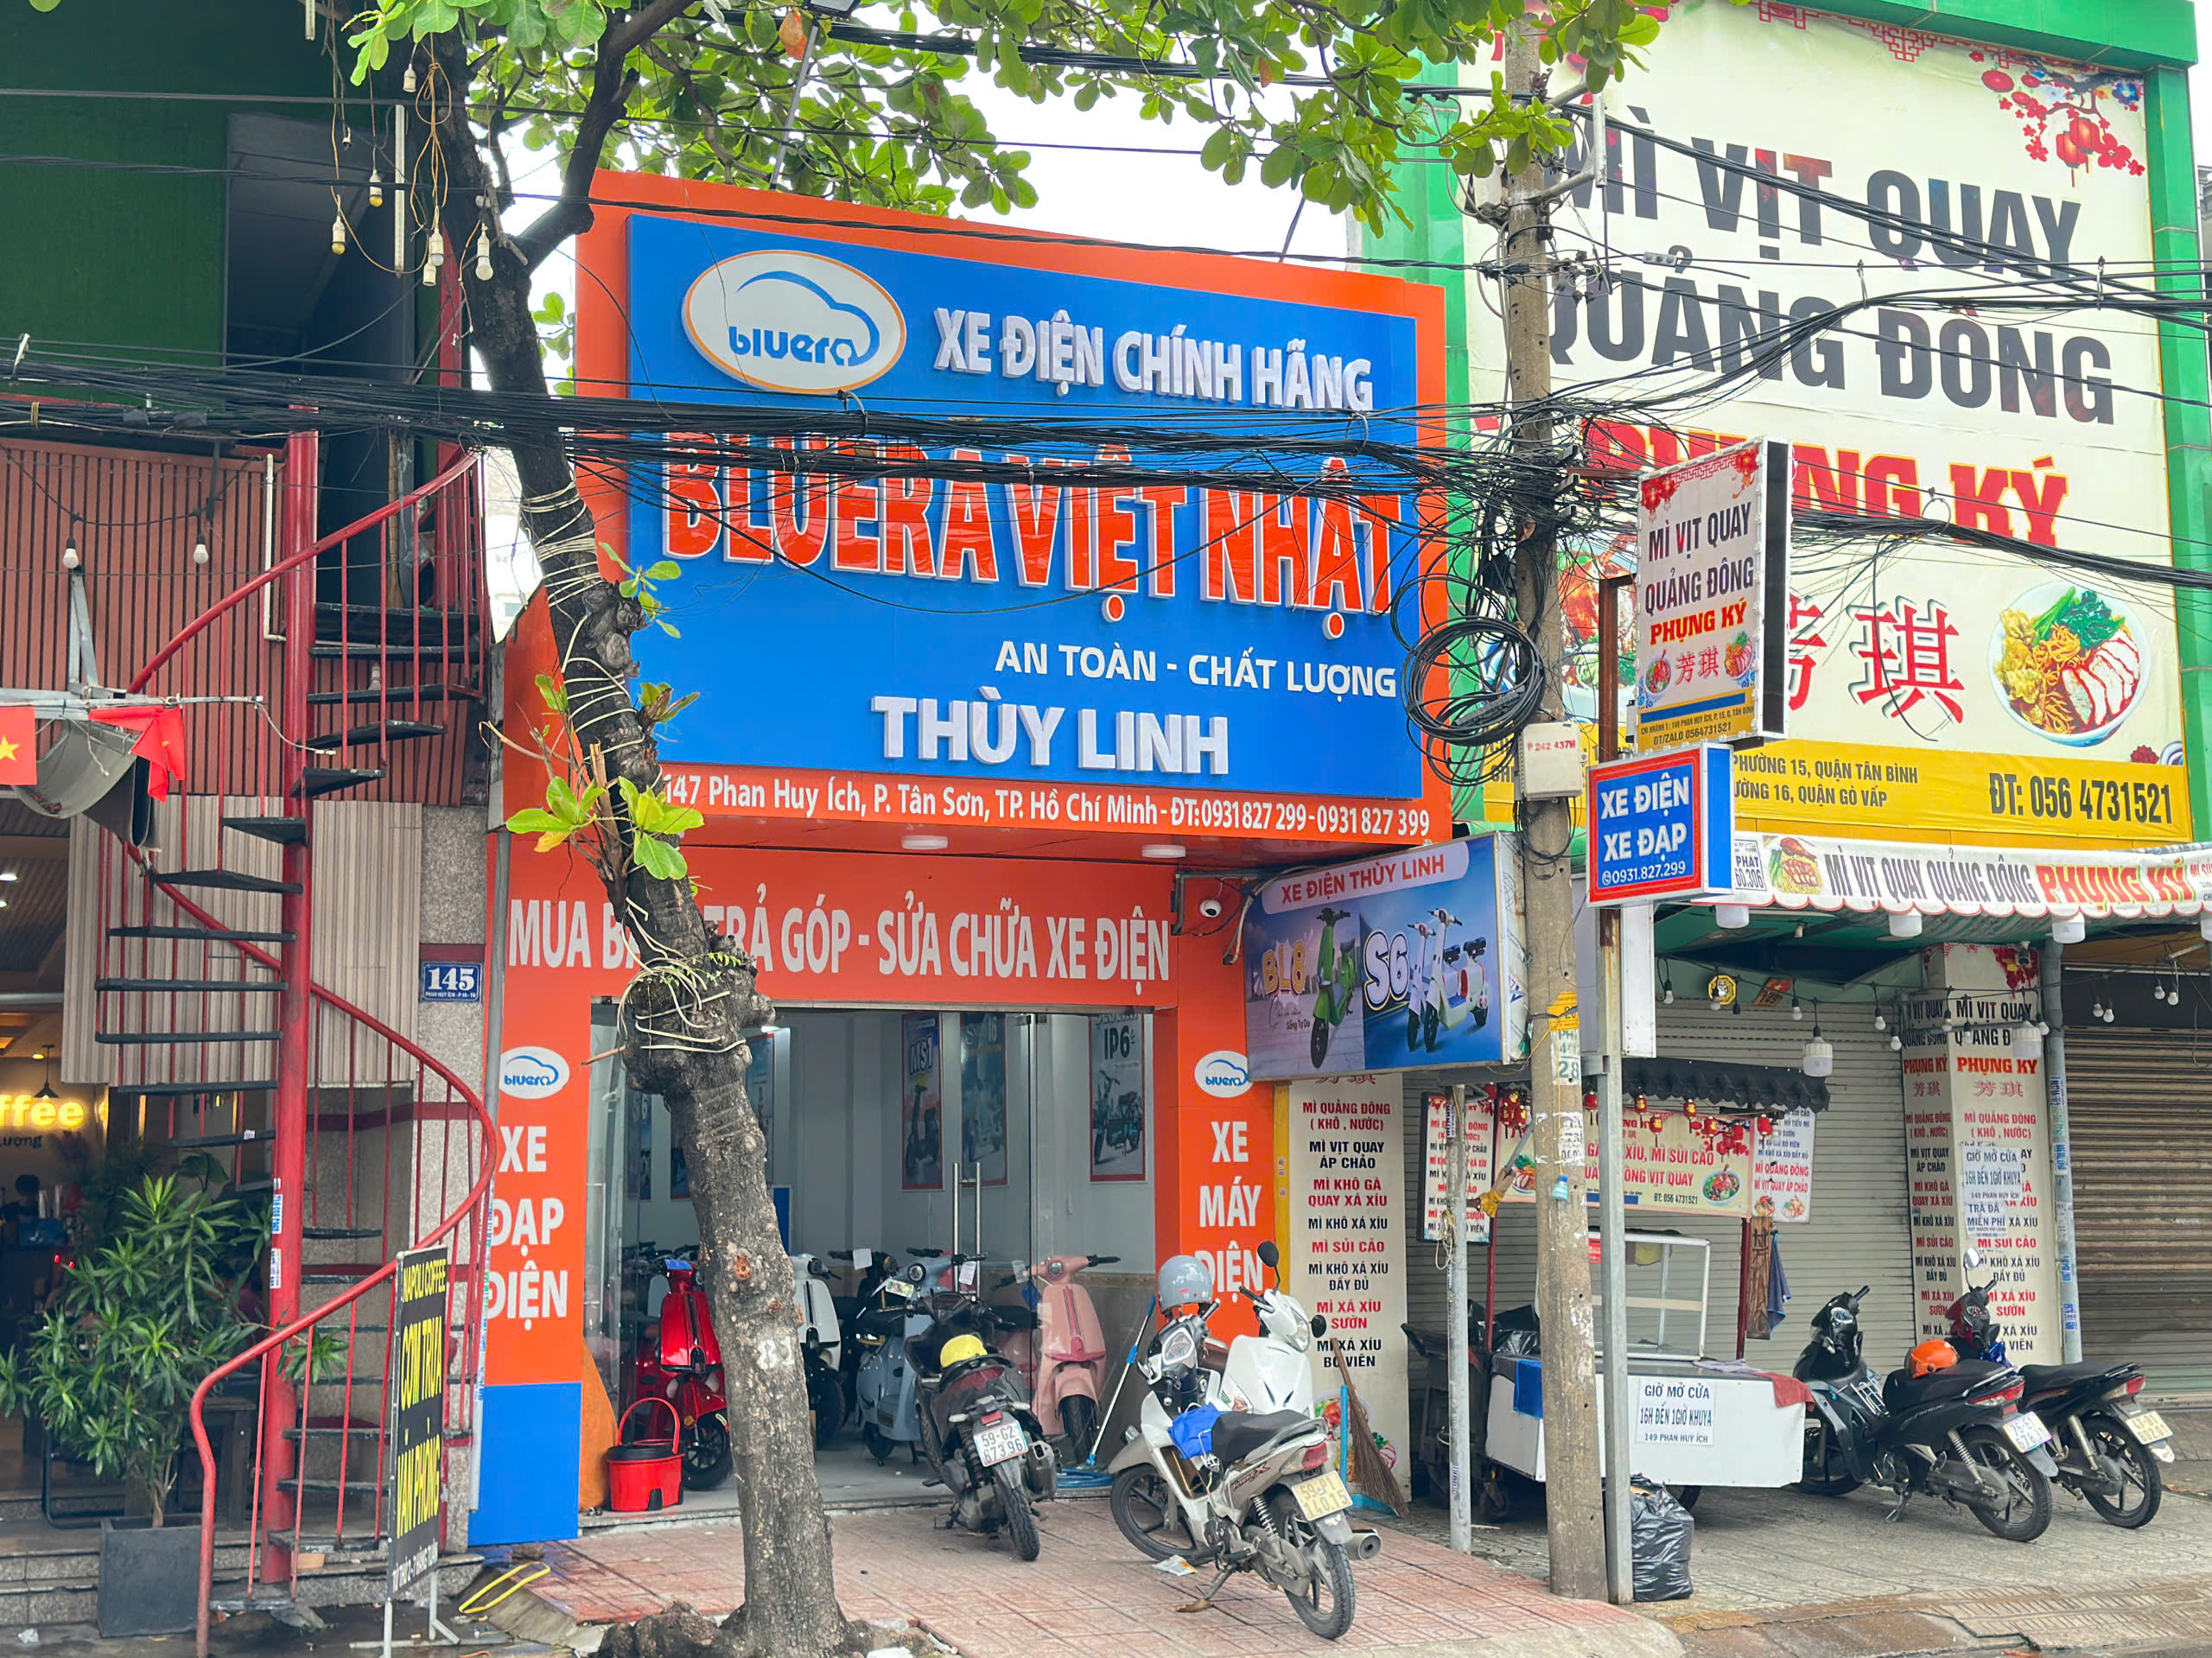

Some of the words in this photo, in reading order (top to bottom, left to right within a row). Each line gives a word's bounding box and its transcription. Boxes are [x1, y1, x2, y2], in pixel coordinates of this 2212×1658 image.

[1691, 137, 1832, 259] VỊT
[1866, 169, 2081, 280] QUAY
[933, 308, 992, 374] XE
[1000, 309, 1104, 397] ĐIỆN
[1113, 324, 1243, 402] CHÍNH
[1252, 338, 1374, 412] HÃNG
[1875, 302, 2114, 425] ĐÔNG
[1949, 455, 2069, 548] KÝ
[663, 430, 1000, 582] BLUERA
[1004, 443, 1187, 623] VIỆT
[1199, 456, 1402, 639] NHẬT
[1649, 519, 1670, 562] MÌ
[1675, 516, 1702, 560] VỊT
[1707, 501, 1751, 548] QUAY
[1644, 568, 1701, 617] QUẢNG
[1707, 557, 1755, 599] ĐÔNG
[1649, 609, 1715, 645] PHỤNG
[1720, 597, 1747, 629] KÝ
[995, 640, 1047, 675] AN
[1058, 642, 1156, 682] TOÀN
[1188, 646, 1277, 691] CHẤT
[1287, 660, 1397, 703] LƯỢNG
[871, 686, 1065, 766] THÙY
[1078, 708, 1229, 775] LINH
[1790, 759, 1812, 778] 15,
[1815, 759, 1853, 782] QUẬN
[1856, 761, 1882, 782] TÂN
[1886, 763, 1918, 784] BÌNH
[709, 774, 766, 808] Phan
[773, 778, 819, 818] Huy
[828, 776, 867, 817] Ích,
[874, 787, 892, 814] P.
[898, 785, 937, 816] Tân
[943, 787, 990, 823] Sơn,
[995, 790, 1025, 819] TP.
[1030, 787, 1059, 821] Hồ
[1066, 790, 1101, 824] Chí
[1600, 788, 1629, 820] XE
[1634, 772, 1690, 816] ĐIỆN
[1773, 784, 1794, 804] 16,
[1798, 784, 1835, 807] QUẬN
[1840, 785, 1858, 805] GÒ
[1861, 785, 1887, 807] VẤP
[1989, 772, 2024, 816] ĐT:
[2031, 775, 2073, 818] 056
[2079, 778, 2172, 824] 4731521
[1604, 831, 1631, 861] XE
[1637, 823, 1688, 861] ĐẠP
[1281, 885, 1301, 905] XE
[1306, 873, 1345, 901] ĐIỆN
[1349, 863, 1397, 890] THÙY
[1402, 854, 1445, 880] LINH
[1612, 861, 1686, 884] 0931.827.299
[1824, 845, 1853, 896] MÌ
[1850, 854, 1881, 908] VỊT
[1881, 858, 1928, 903] QUAY
[1926, 847, 1986, 905] QUẢNG
[1986, 854, 2040, 905] ĐÔNG
[2036, 865, 2153, 912] PHỤNG
[2146, 856, 2196, 902] KÝ
[509, 899, 591, 968] MUA
[782, 893, 851, 974] GÓP
[878, 890, 942, 976] SỬA
[950, 897, 1037, 978] CHỮA
[1046, 917, 1086, 980] XE
[1095, 905, 1169, 995] ĐIỆN
[429, 968, 474, 991] 145
[1262, 940, 1306, 994] BL8
[1977, 1001, 1997, 1023] VỊT
[1956, 1057, 2012, 1076] PHỤNG
[1303, 1100, 1317, 1114] MÌ
[1320, 1099, 1357, 1115] QUẢNG
[1361, 1102, 1390, 1115] ĐÔNG
[1979, 1109, 2010, 1124] QUẢNG
[1318, 1116, 1340, 1130] KHÔ
[499, 1126, 547, 1172] XE
[1211, 1121, 1249, 1162] XE
[1310, 1140, 1325, 1153] MÌ
[1319, 1155, 1337, 1169] ÁP
[1341, 1154, 1376, 1169] CHẢO
[1691, 1147, 1714, 1166] CẢO
[1313, 1177, 1330, 1191] MÌ
[1334, 1177, 1360, 1191] KHÔ
[1364, 1177, 1382, 1191] GÀ
[1649, 1171, 1666, 1188] VỊT
[1668, 1172, 1694, 1187] QUAY
[1199, 1176, 1262, 1228] MÁY
[1366, 1192, 1388, 1206] XÍU
[1308, 1216, 1322, 1229] MÌ
[1325, 1216, 1348, 1229] KHÔ
[1370, 1216, 1388, 1229] XÍU
[1312, 1239, 1328, 1253] MÌ
[1332, 1238, 1355, 1253] SỦI
[1358, 1238, 1385, 1253] CẢO
[424, 1259, 446, 1297] COFFEE
[1308, 1261, 1322, 1274] MÌ
[1326, 1261, 1349, 1274] KHÔ
[1370, 1260, 1389, 1274] XÍU
[1354, 1276, 1369, 1291] ĐỦ
[1317, 1299, 1333, 1313] MÌ
[1359, 1299, 1382, 1312] XÍU
[1360, 1337, 1382, 1350] XÍU
[1346, 1354, 1376, 1367] VIÊN
[1644, 1382, 1664, 1397] GIỜ
[1667, 1382, 1685, 1398] MỞ
[1688, 1382, 1710, 1399] CỬA
[1640, 1407, 1654, 1425] 16H
[1655, 1401, 1670, 1425] ĐẾN
[1688, 1409, 1712, 1426] KHUYA
[982, 1426, 1016, 1447] 59-G2
